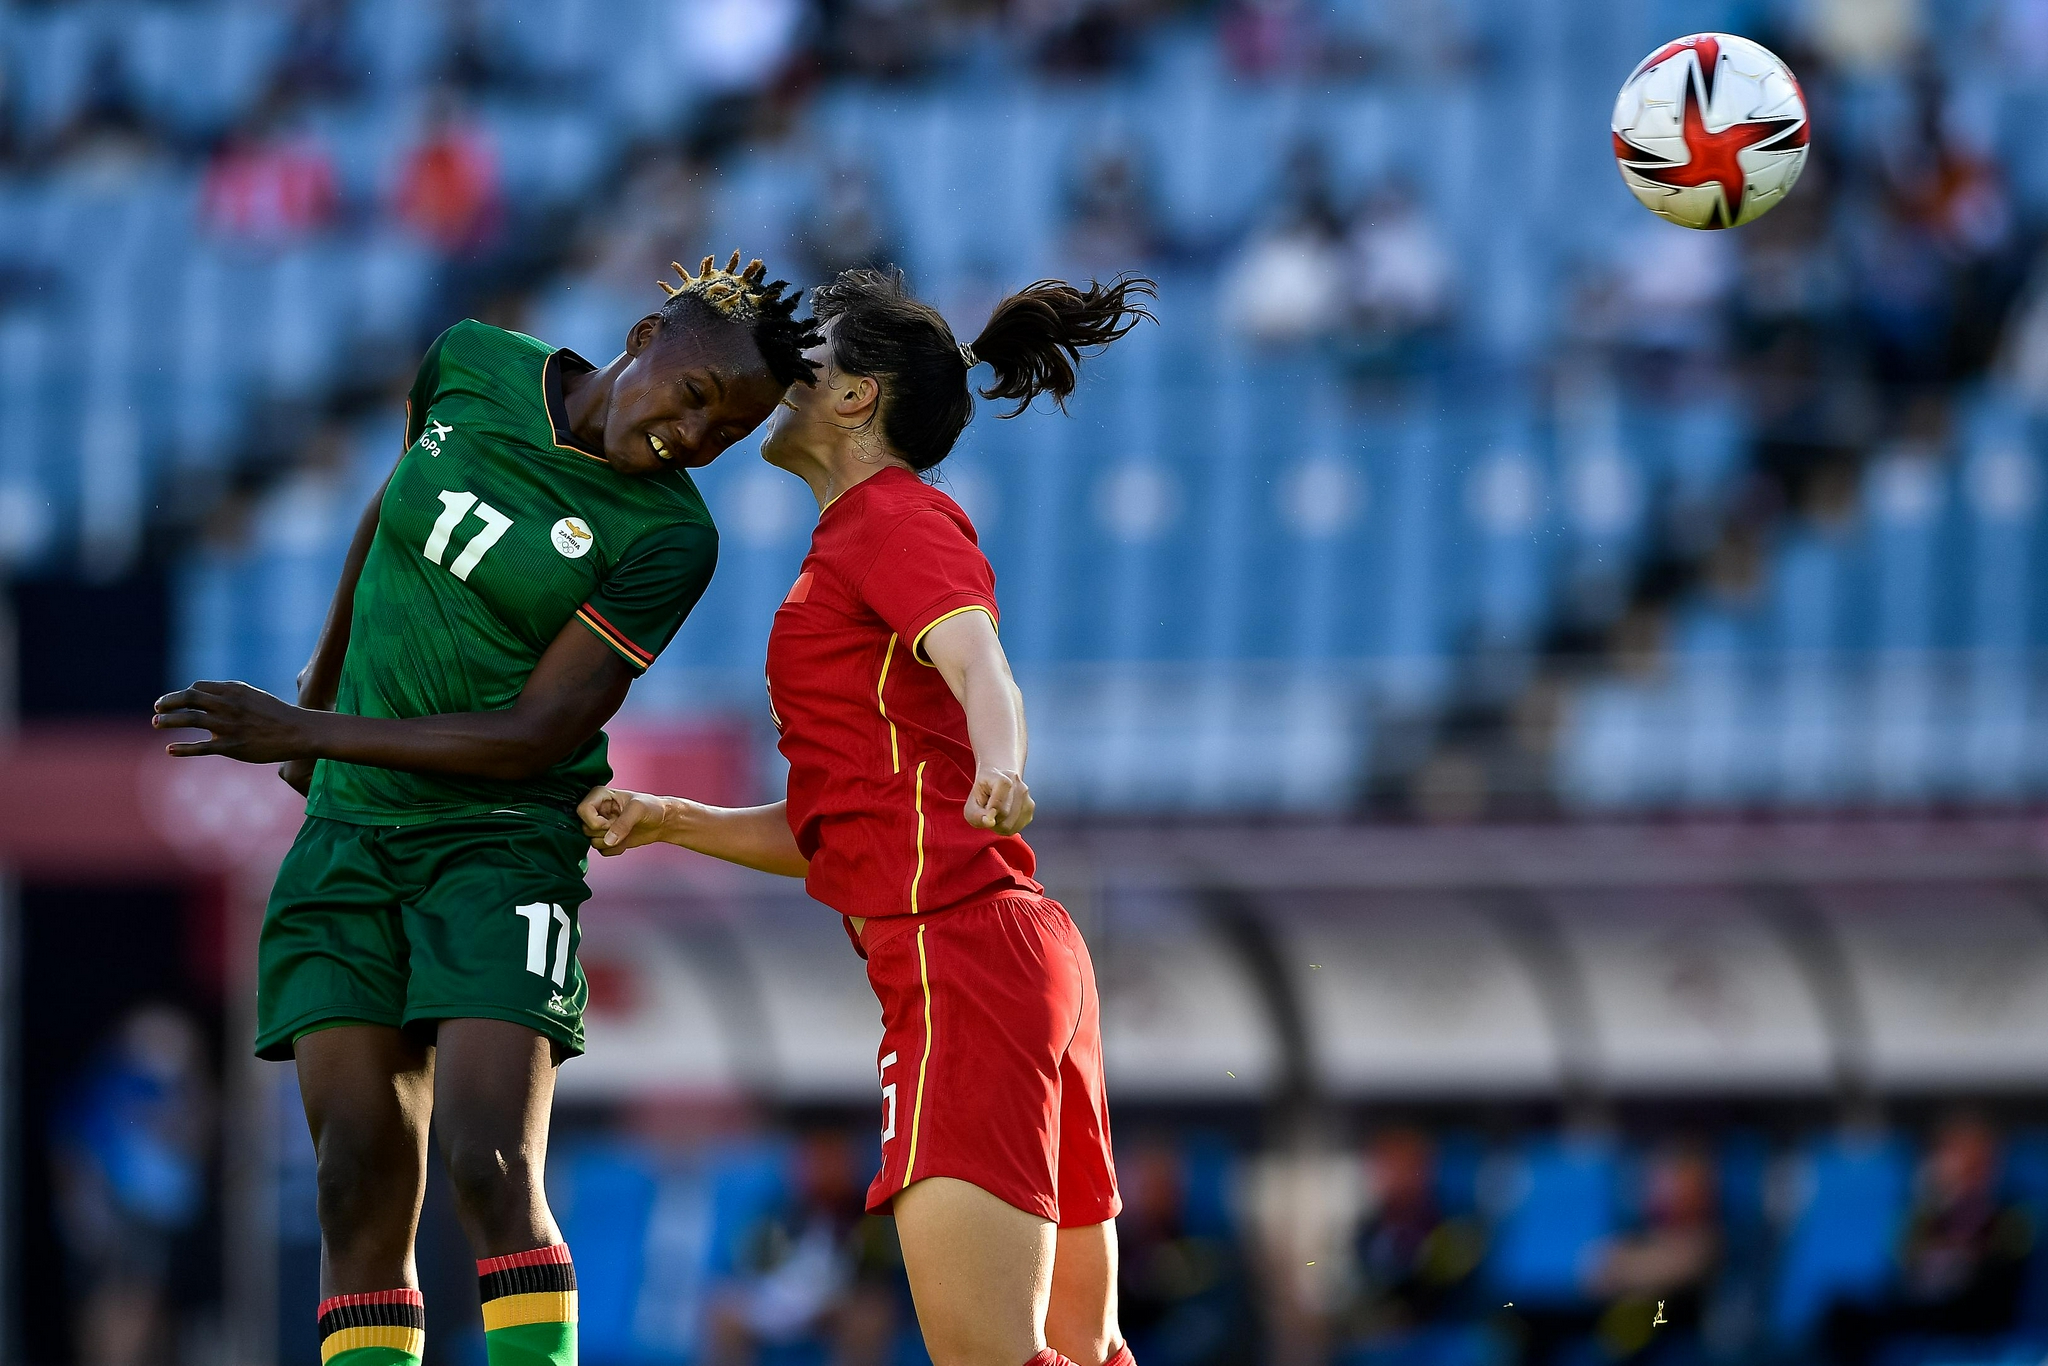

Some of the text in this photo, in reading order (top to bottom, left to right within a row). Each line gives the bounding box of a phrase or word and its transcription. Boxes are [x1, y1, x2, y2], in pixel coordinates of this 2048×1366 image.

[423, 489, 515, 582] 17
[558, 529, 581, 551] ZAMBIA
[515, 901, 571, 989] 17
